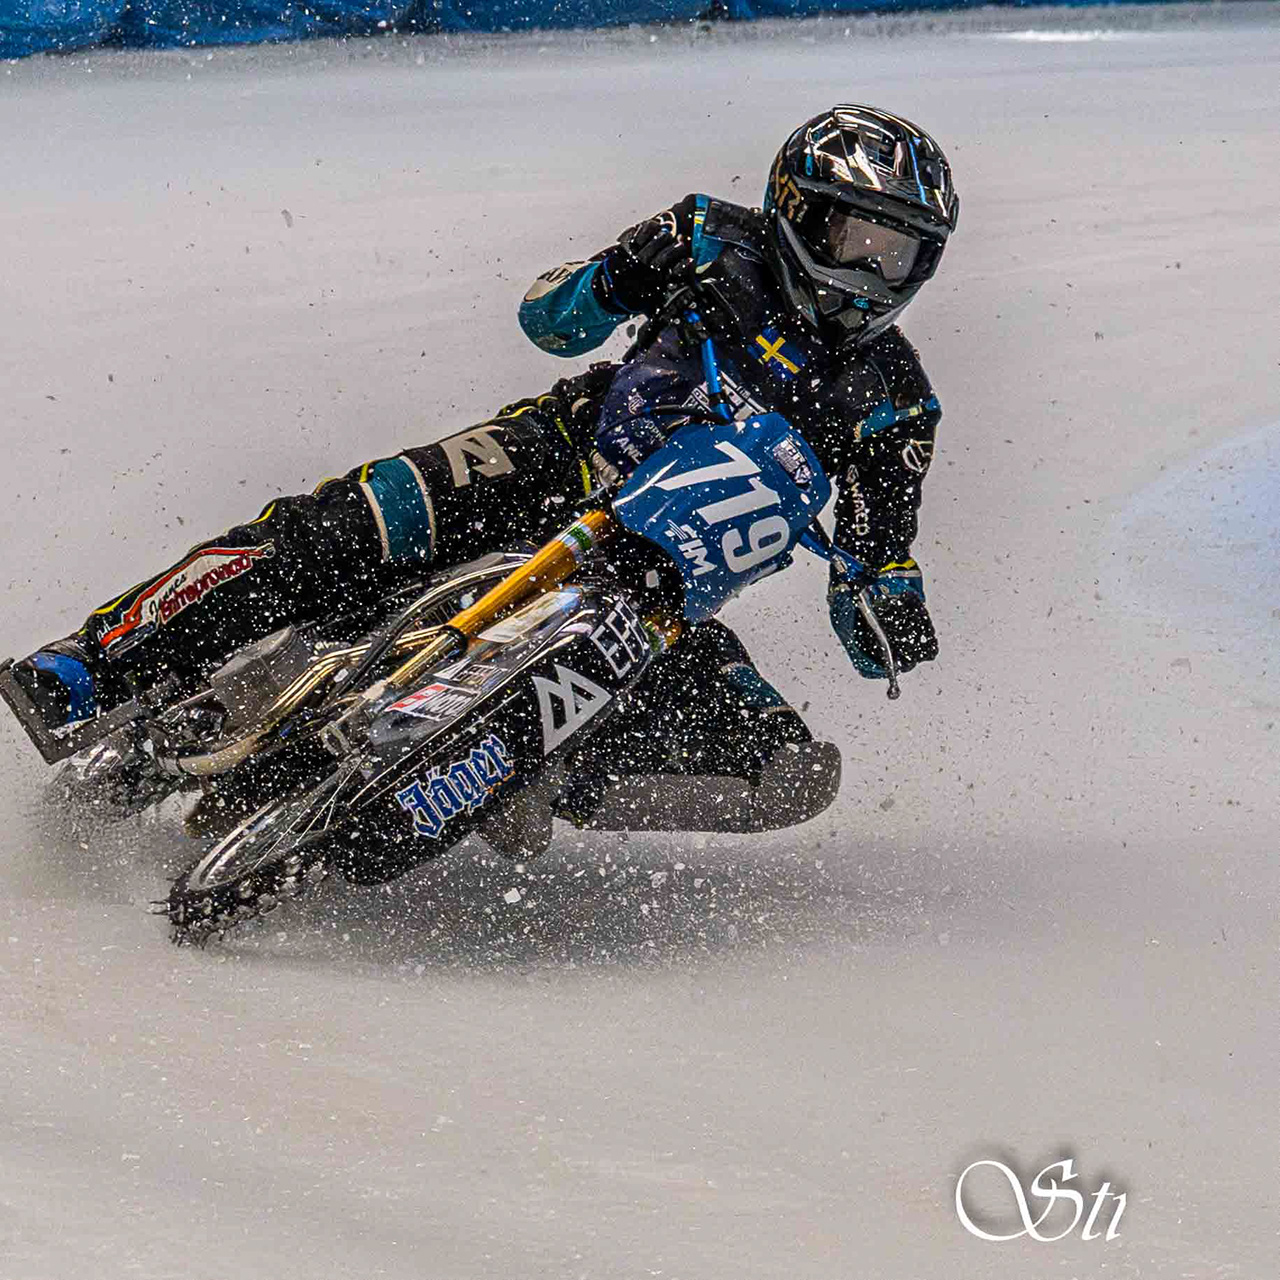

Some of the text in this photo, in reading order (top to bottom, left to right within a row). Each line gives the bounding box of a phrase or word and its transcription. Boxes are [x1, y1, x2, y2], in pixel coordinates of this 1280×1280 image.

[652, 440, 791, 575] 719
[670, 519, 718, 577] FIM
[394, 733, 516, 839] Jäger
